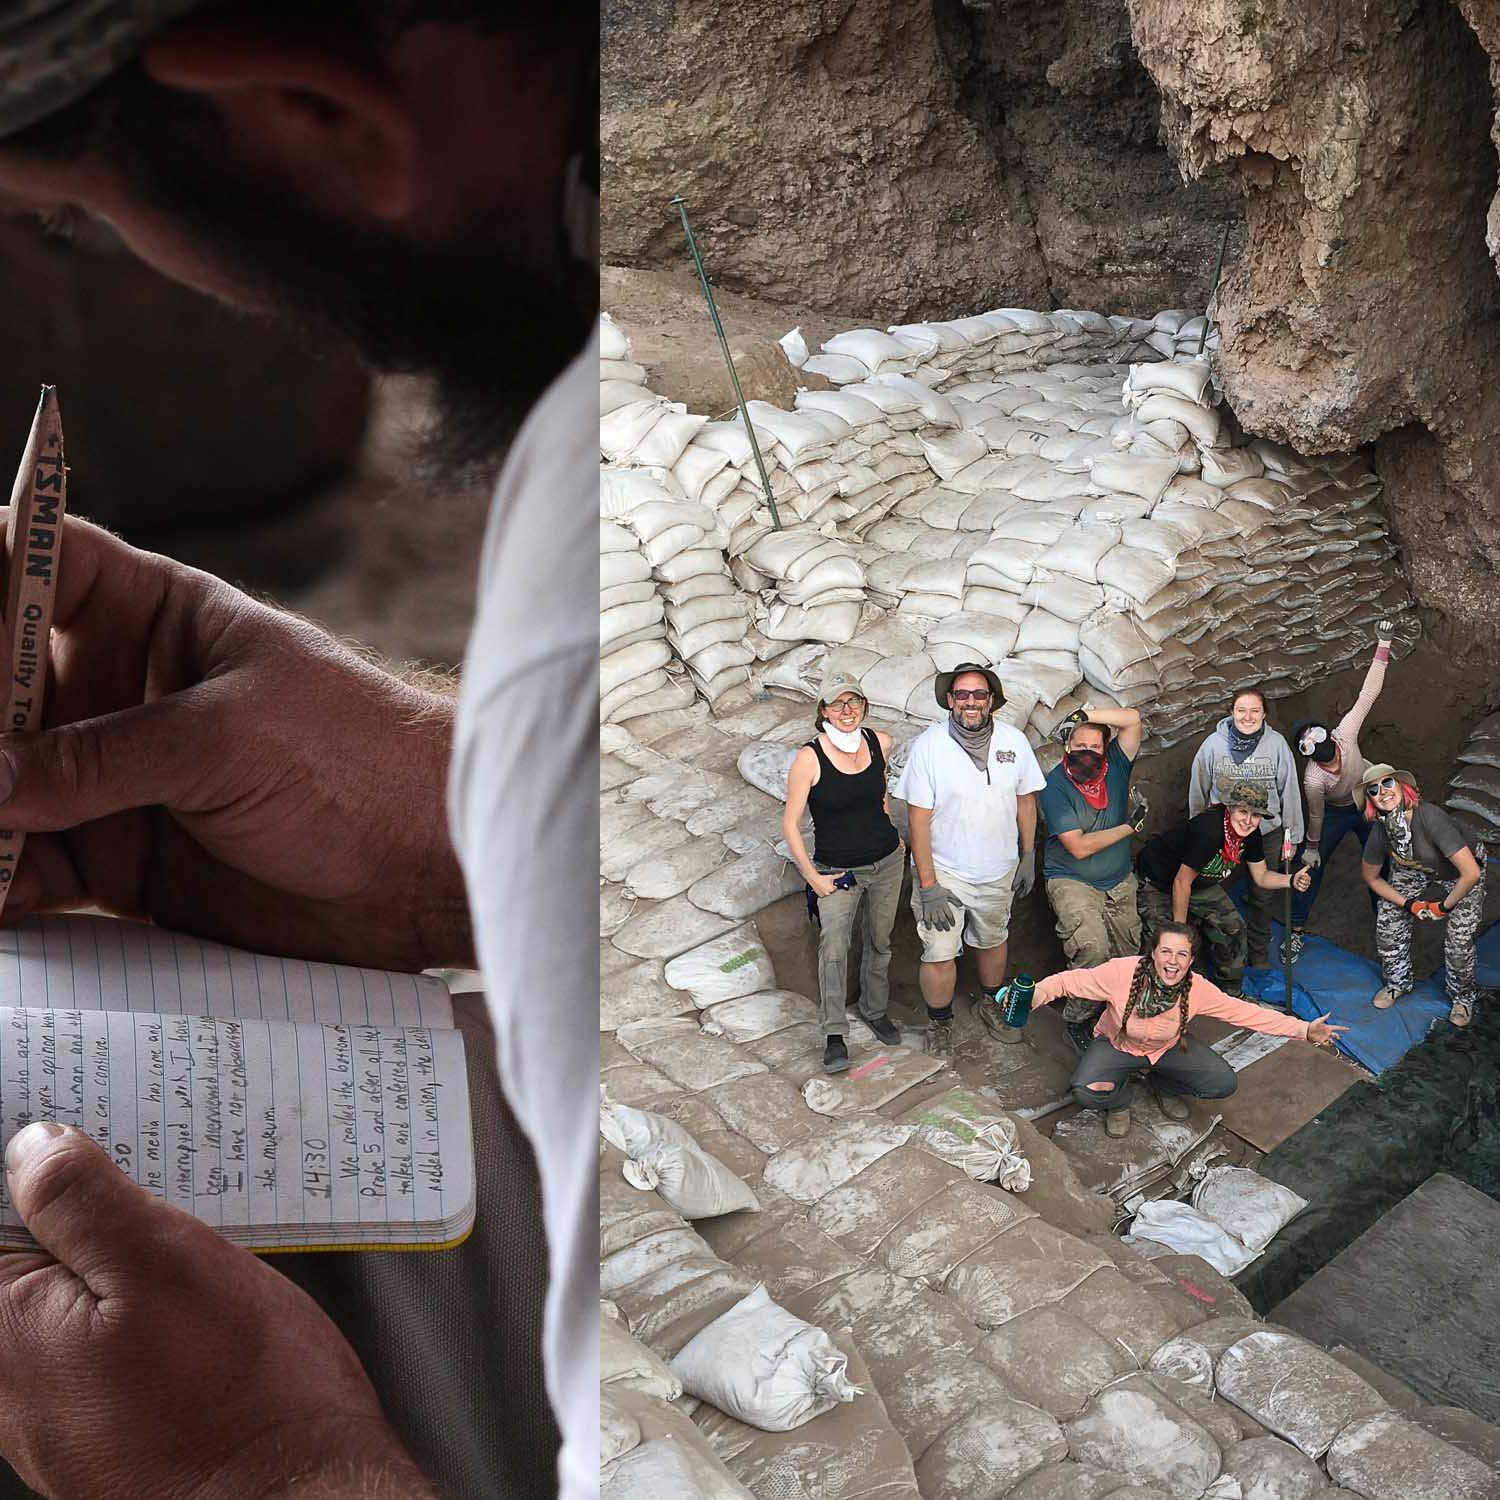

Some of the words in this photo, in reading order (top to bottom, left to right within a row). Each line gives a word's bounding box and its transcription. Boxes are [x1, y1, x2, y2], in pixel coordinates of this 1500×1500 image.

[26, 433, 63, 577] TSMAN
[15, 603, 42, 688] Quality
[138, 1024, 161, 1042] and
[168, 1020, 189, 1042] have
[16, 1039, 30, 1058] are
[60, 1034, 82, 1054] and
[328, 1036, 349, 1072] bottom
[383, 1038, 406, 1055] and
[149, 1050, 162, 1076] come
[170, 1048, 195, 1066] I
[196, 1048, 218, 1068] and
[359, 1049, 384, 1064] all
[413, 1056, 432, 1075] the
[8, 1071, 30, 1099] who
[62, 1066, 84, 1114] human
[138, 1083, 162, 1102] has
[332, 1081, 354, 1100] the
[358, 1070, 382, 1103] after
[384, 1060, 409, 1110] conferred
[95, 1096, 109, 1118] can
[229, 1092, 245, 1117] not
[418, 1083, 442, 1121] unison,
[261, 1108, 278, 1159] museum.
[332, 1104, 357, 1144] reached
[362, 1110, 385, 1134] and
[389, 1122, 409, 1145] and
[140, 1120, 160, 1160] media
[226, 1128, 245, 1160] have
[421, 1130, 439, 1141] in
[363, 1143, 380, 1153] 5
[304, 1138, 331, 1199] 14:30
[339, 1156, 360, 1178] We
[360, 1160, 387, 1196] Probe
[390, 1155, 414, 1195] talked
[415, 1152, 444, 1191] nodded
[195, 1168, 224, 1197] been
[221, 1171, 242, 1192] I
[254, 1168, 276, 1191] the
